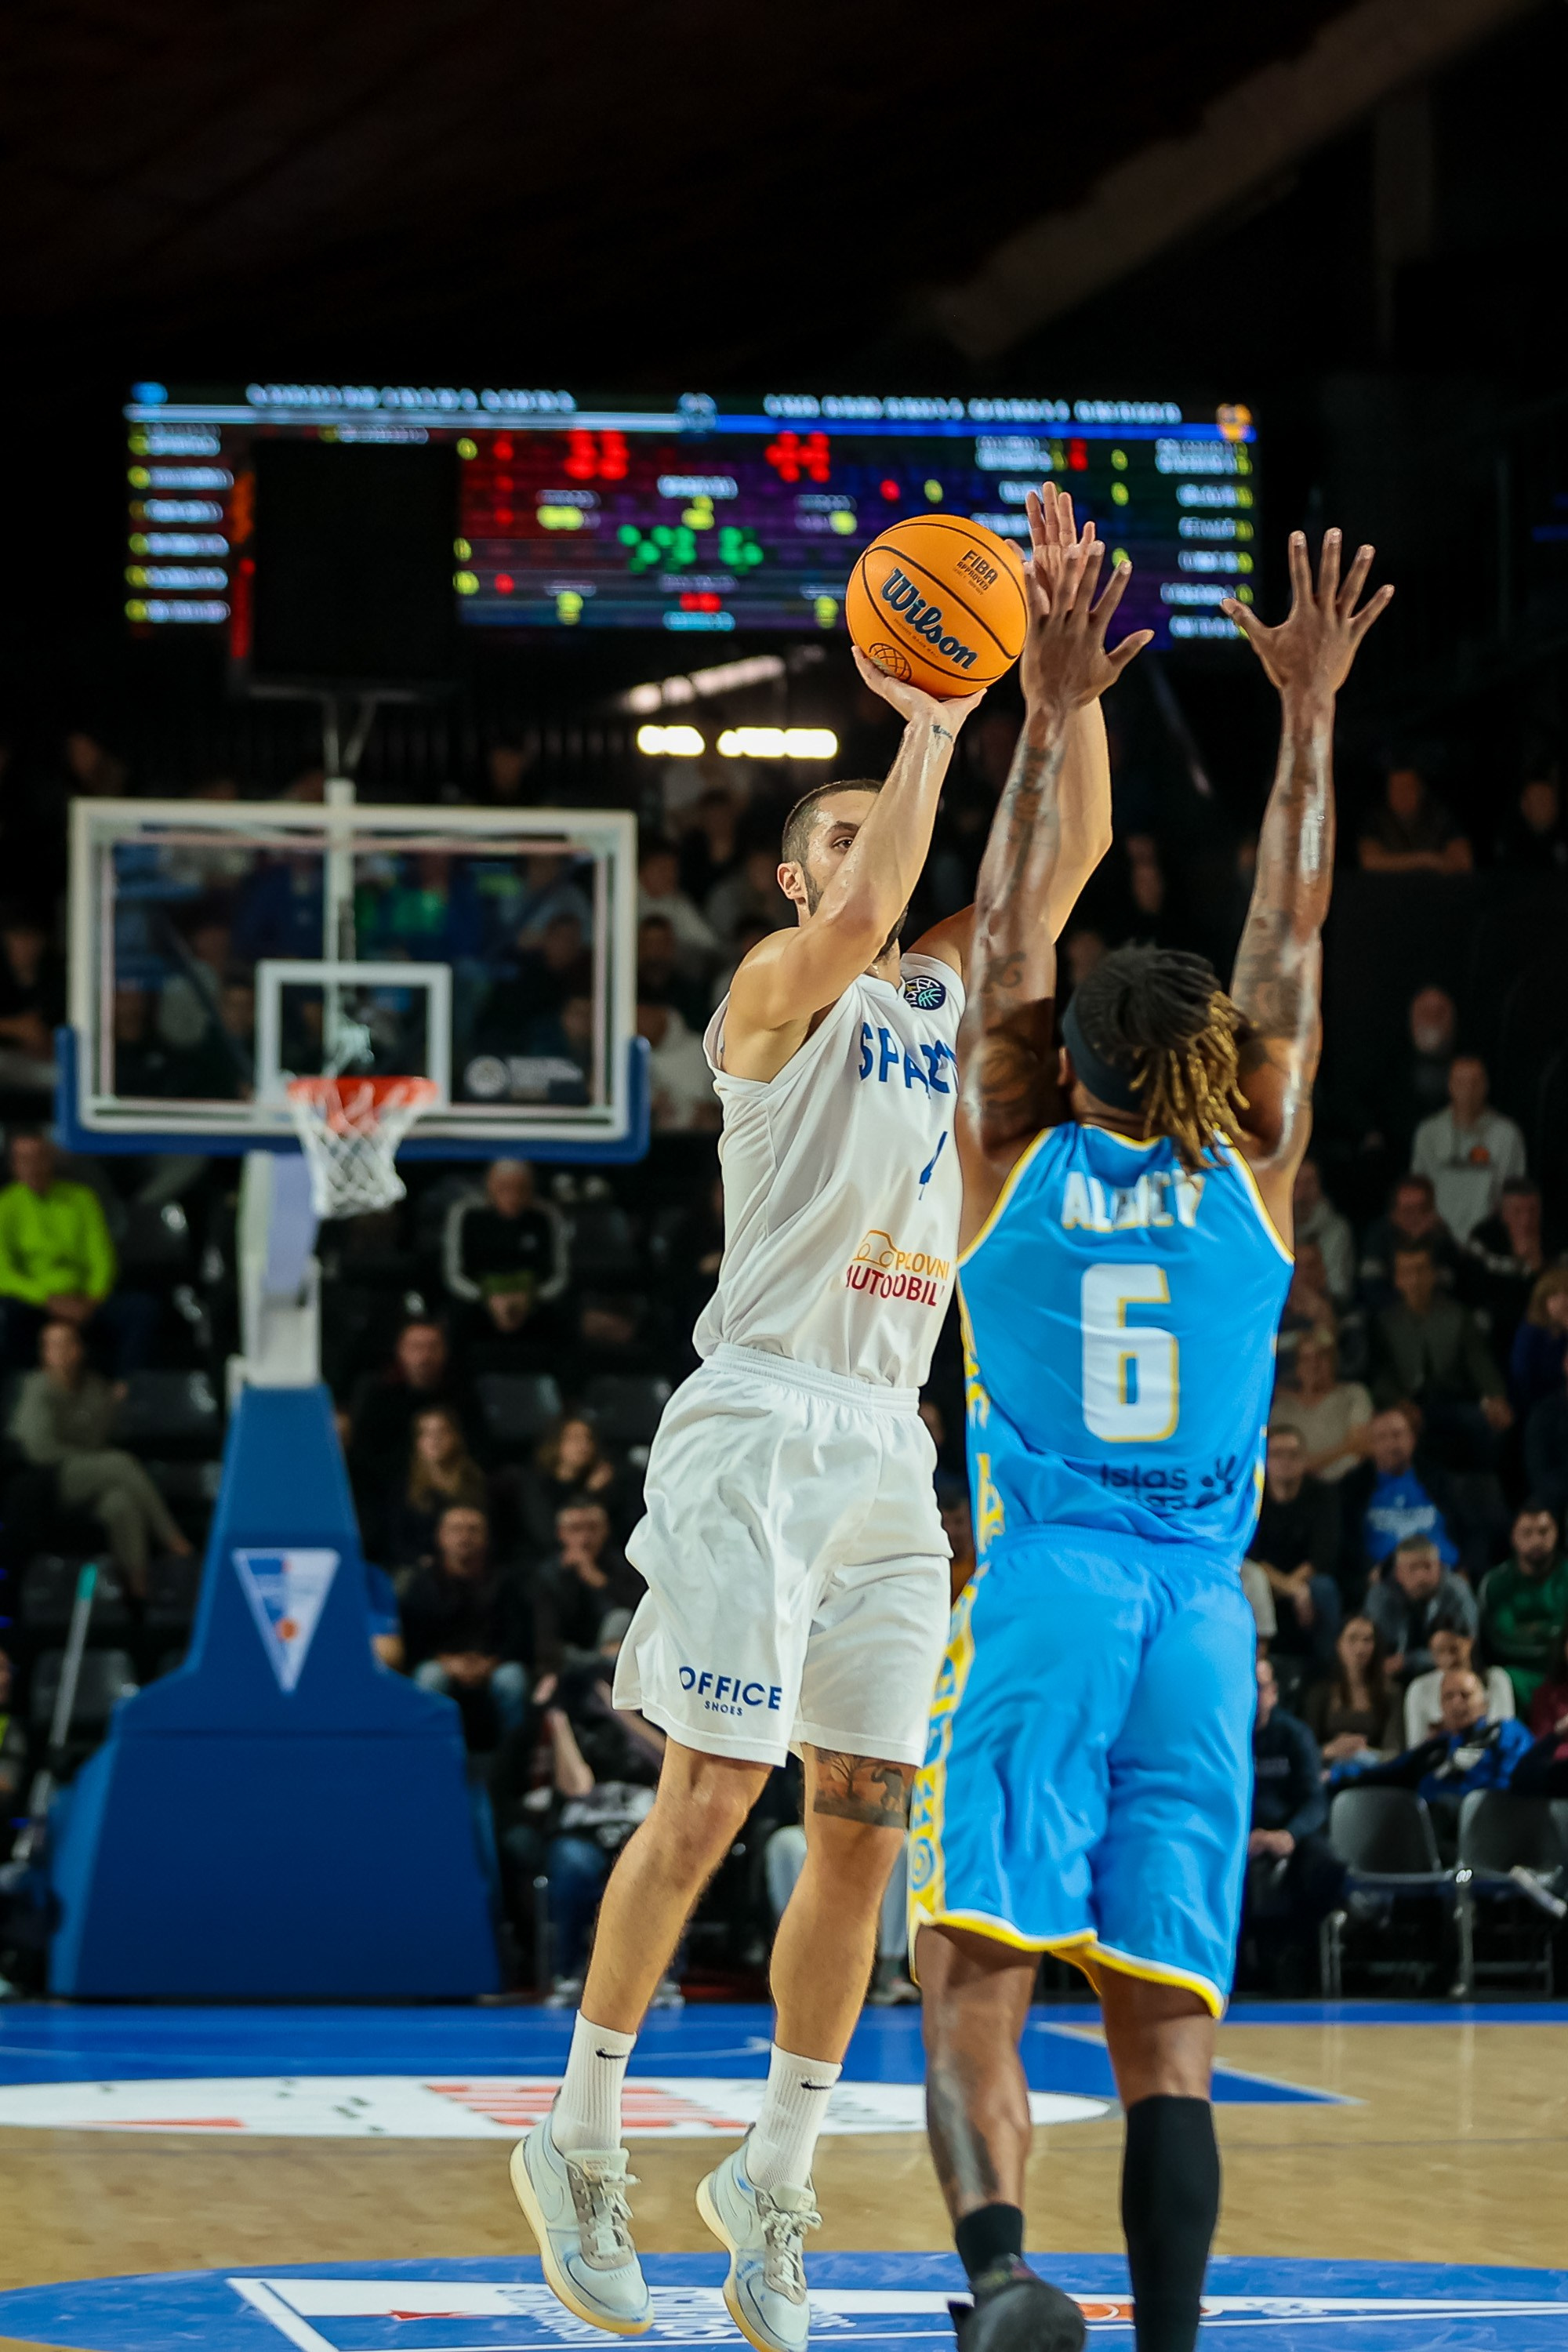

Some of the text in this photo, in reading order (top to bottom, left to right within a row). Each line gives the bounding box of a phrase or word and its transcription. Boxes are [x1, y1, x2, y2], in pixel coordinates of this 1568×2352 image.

[956, 561, 989, 591] APPROVED
[961, 550, 999, 585] FIBA
[880, 568, 978, 671] Wilson
[1080, 1263, 1180, 1443] 6
[1101, 1463, 1188, 1490] Islas
[679, 1666, 782, 1711] OFFICE
[704, 1700, 743, 1716] SHOES
